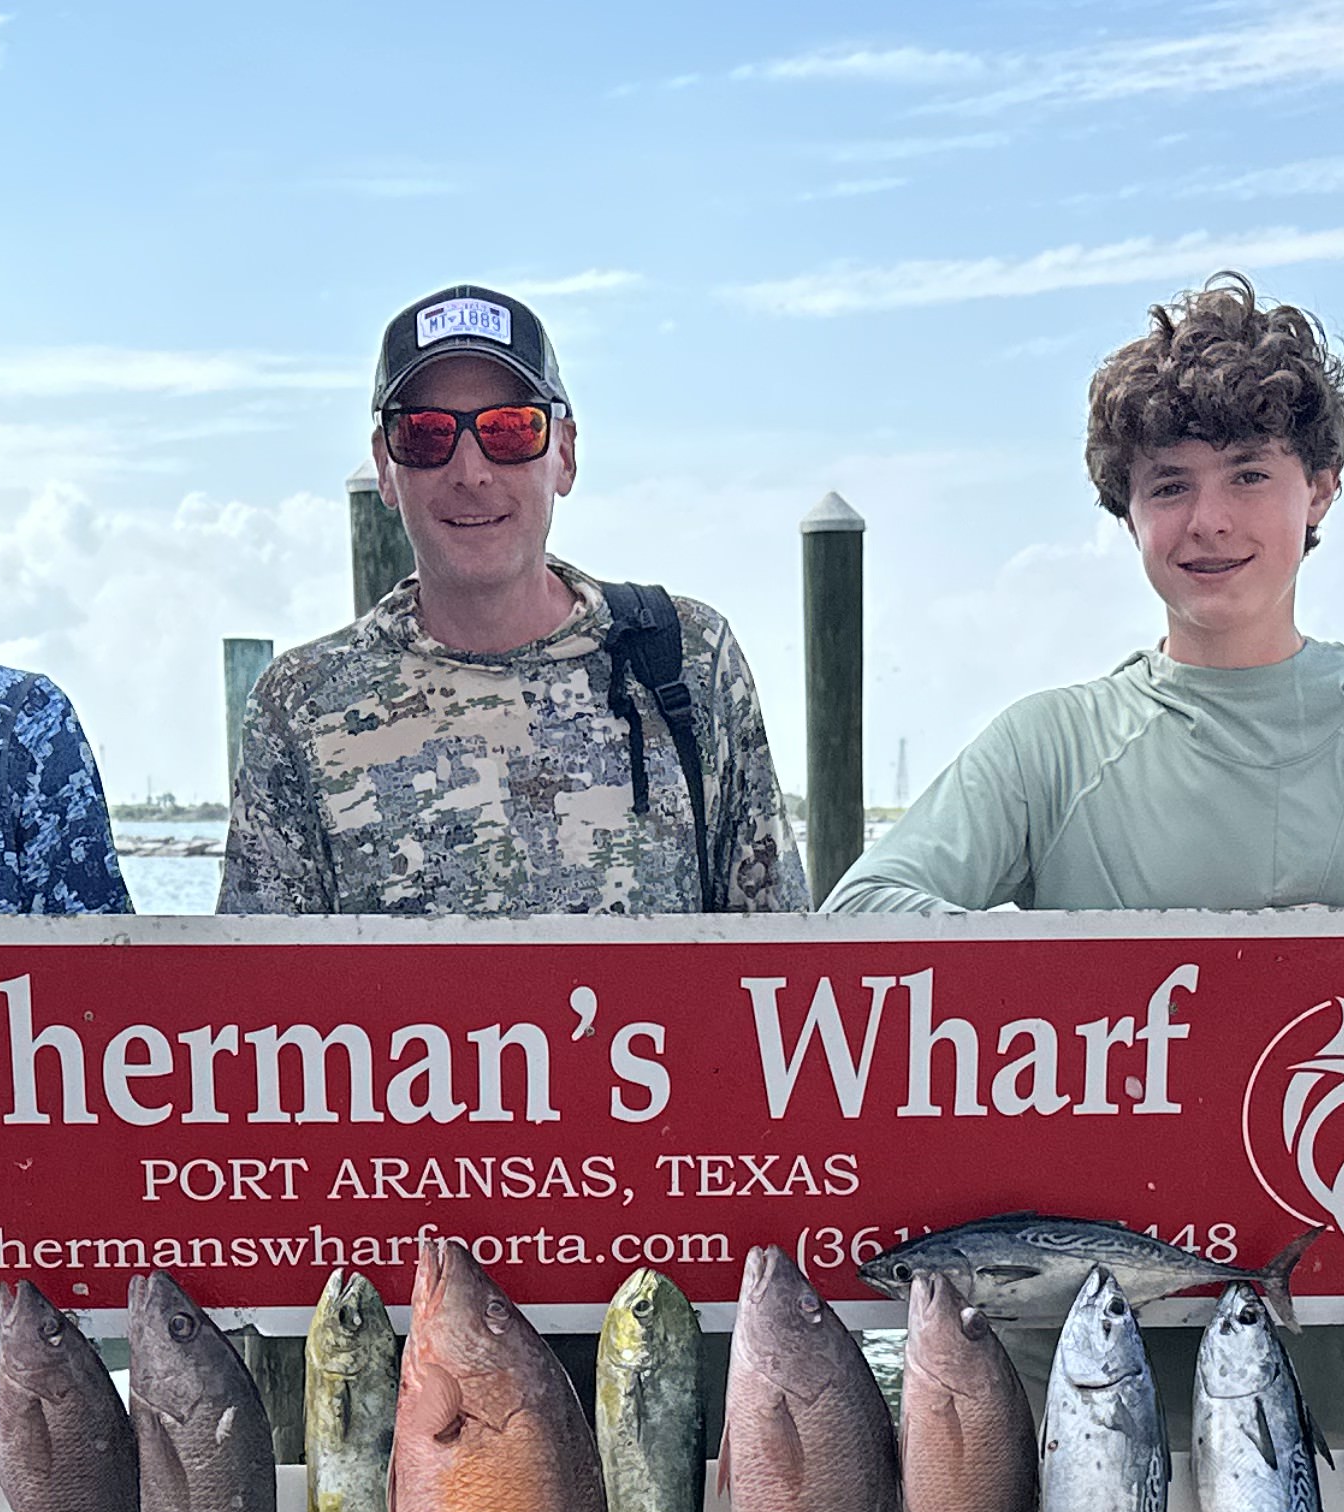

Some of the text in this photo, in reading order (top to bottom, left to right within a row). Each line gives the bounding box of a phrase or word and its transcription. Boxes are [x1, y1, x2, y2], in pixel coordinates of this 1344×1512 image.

[740, 963, 1199, 1119] Wharf
[140, 1154, 860, 1206] PORT ARANSAS, TEXAS
